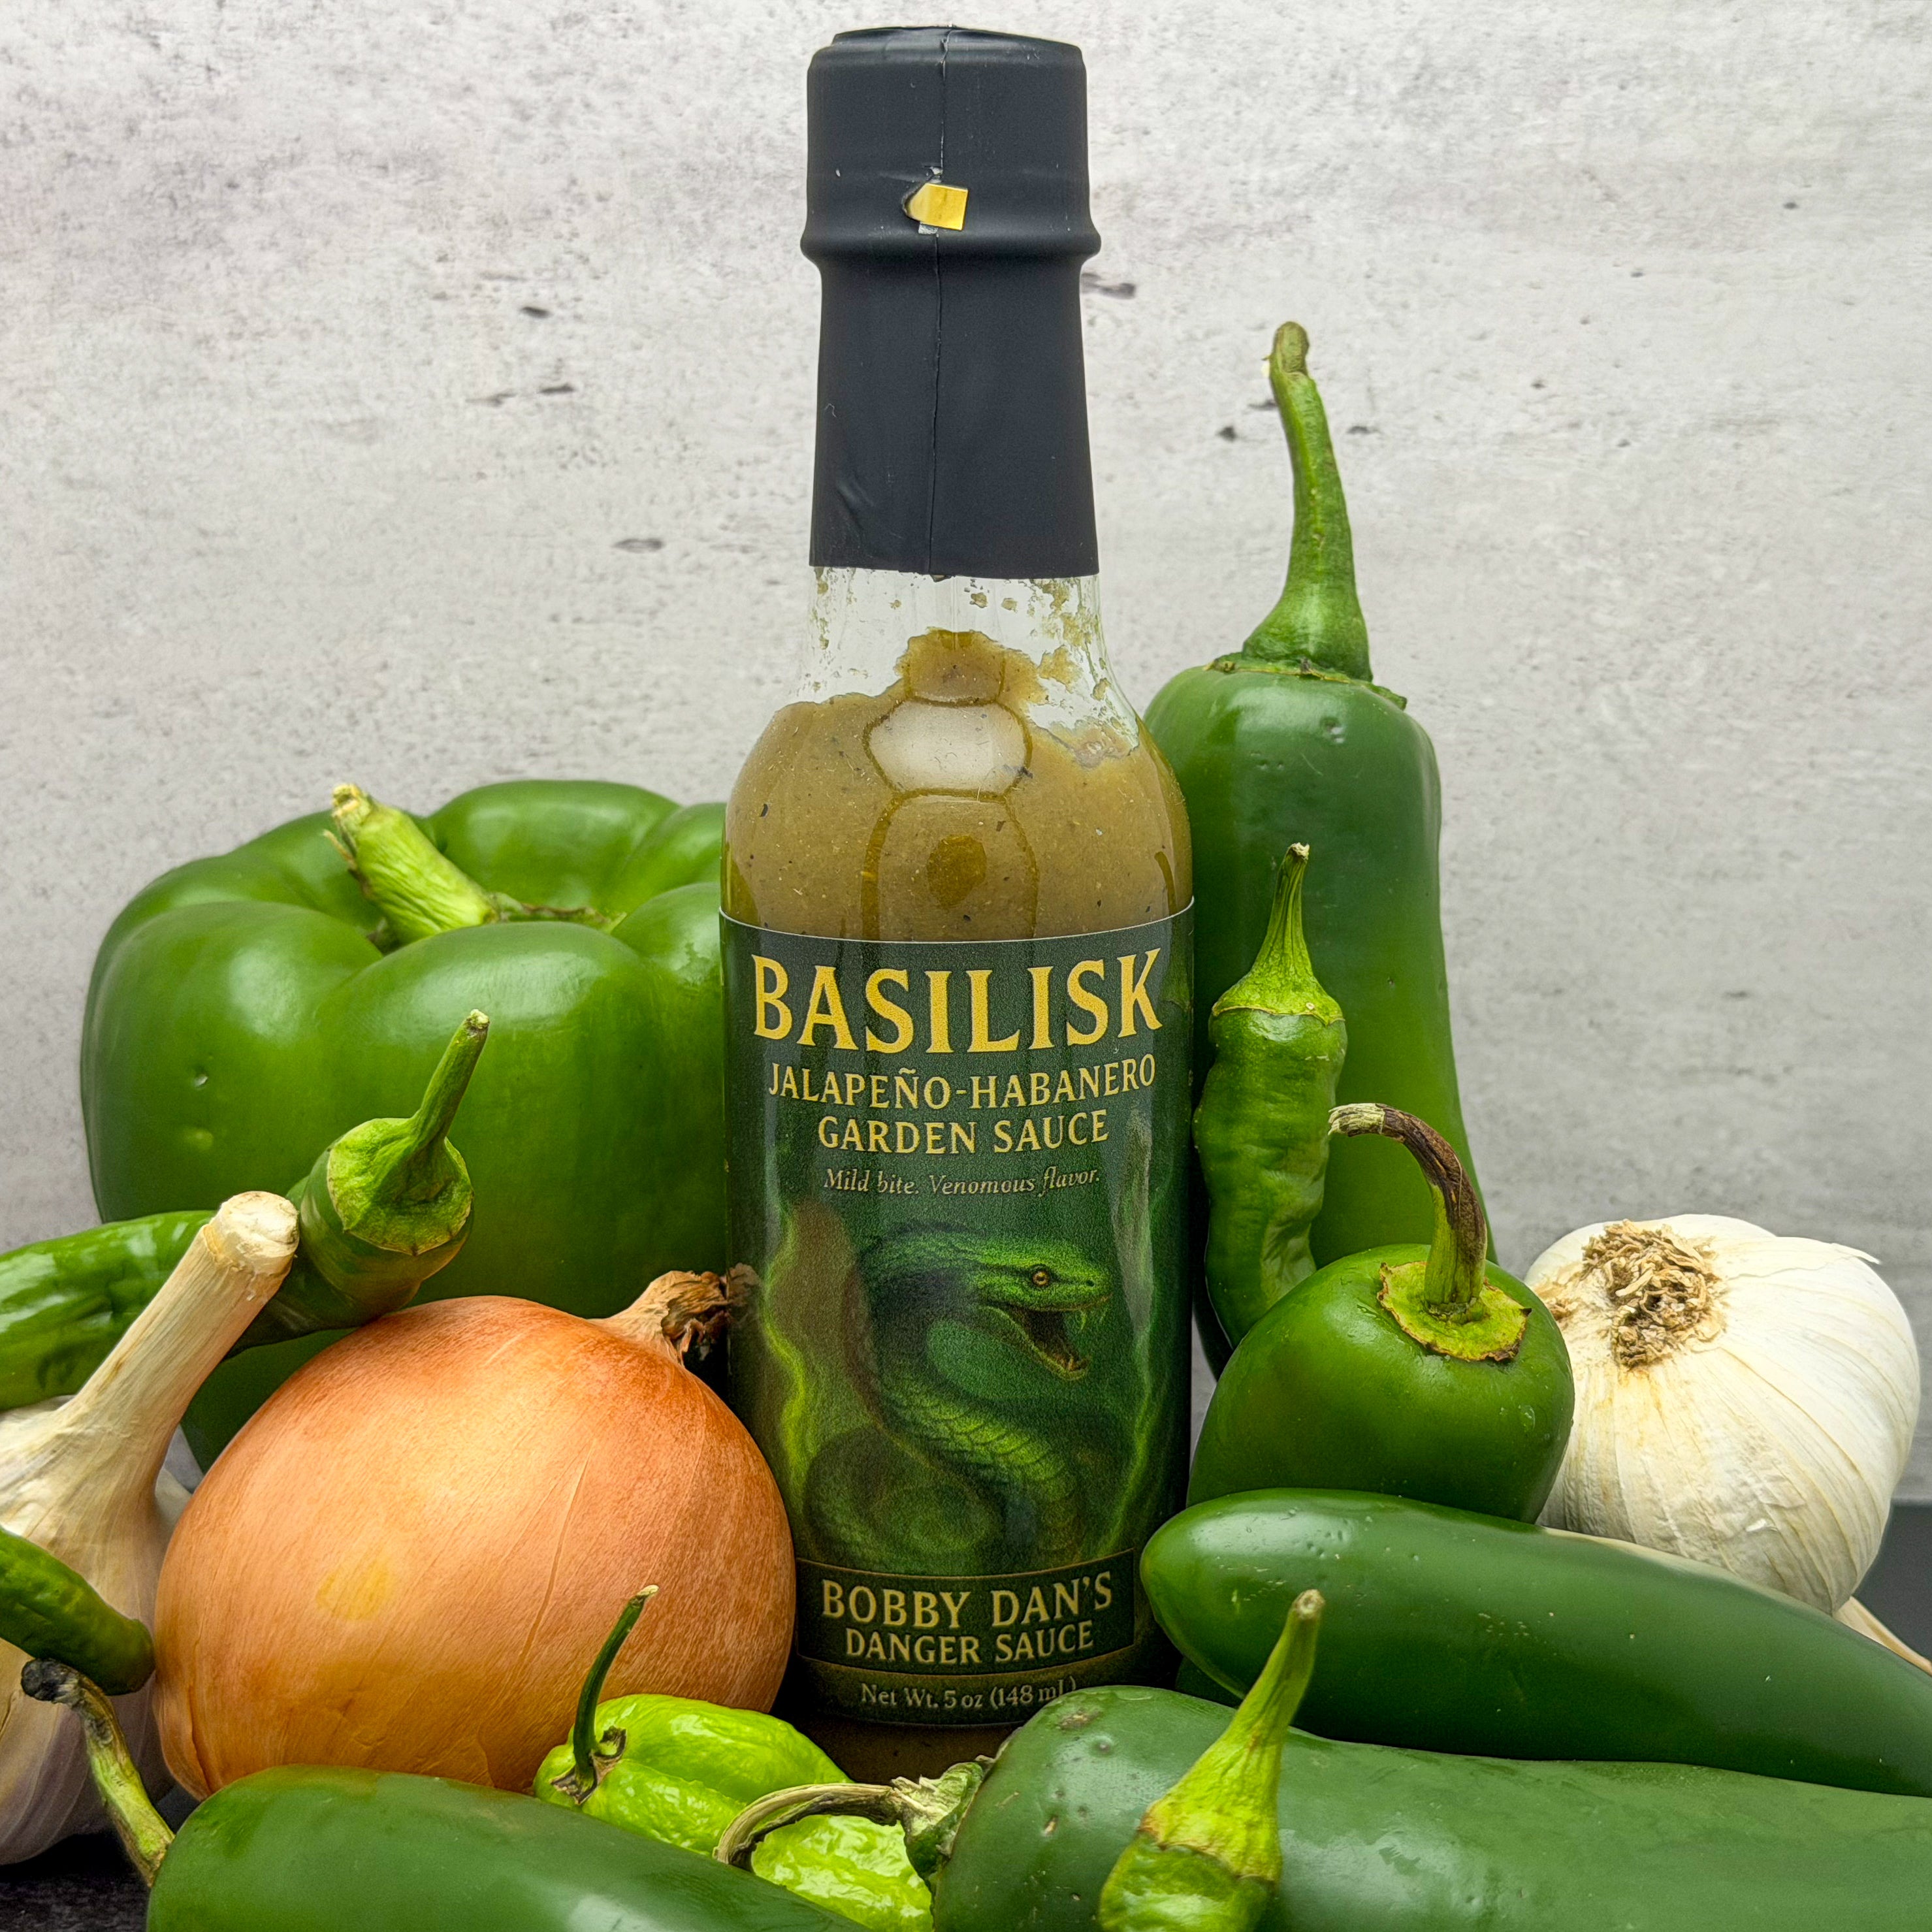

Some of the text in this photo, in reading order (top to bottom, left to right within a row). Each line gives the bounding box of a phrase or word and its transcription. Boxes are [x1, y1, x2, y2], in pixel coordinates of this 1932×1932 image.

[751, 947, 1163, 1054] BASILISK
[769, 1053, 1156, 1110] JALAPEÑO-HABANERO
[818, 1108, 1110, 1154] GARDEN SAUCE
[823, 1166, 1100, 1198] Mild bite. Venomous flavor.
[822, 1570, 1112, 1629] BOBBY DAN'S
[846, 1620, 1093, 1665] DANGER SAUCE
[861, 1682, 897, 1706] Net
[903, 1687, 939, 1709] Wt.
[944, 1690, 957, 1709] 5
[961, 1693, 983, 1709] oz
[990, 1684, 1034, 1711] (148
